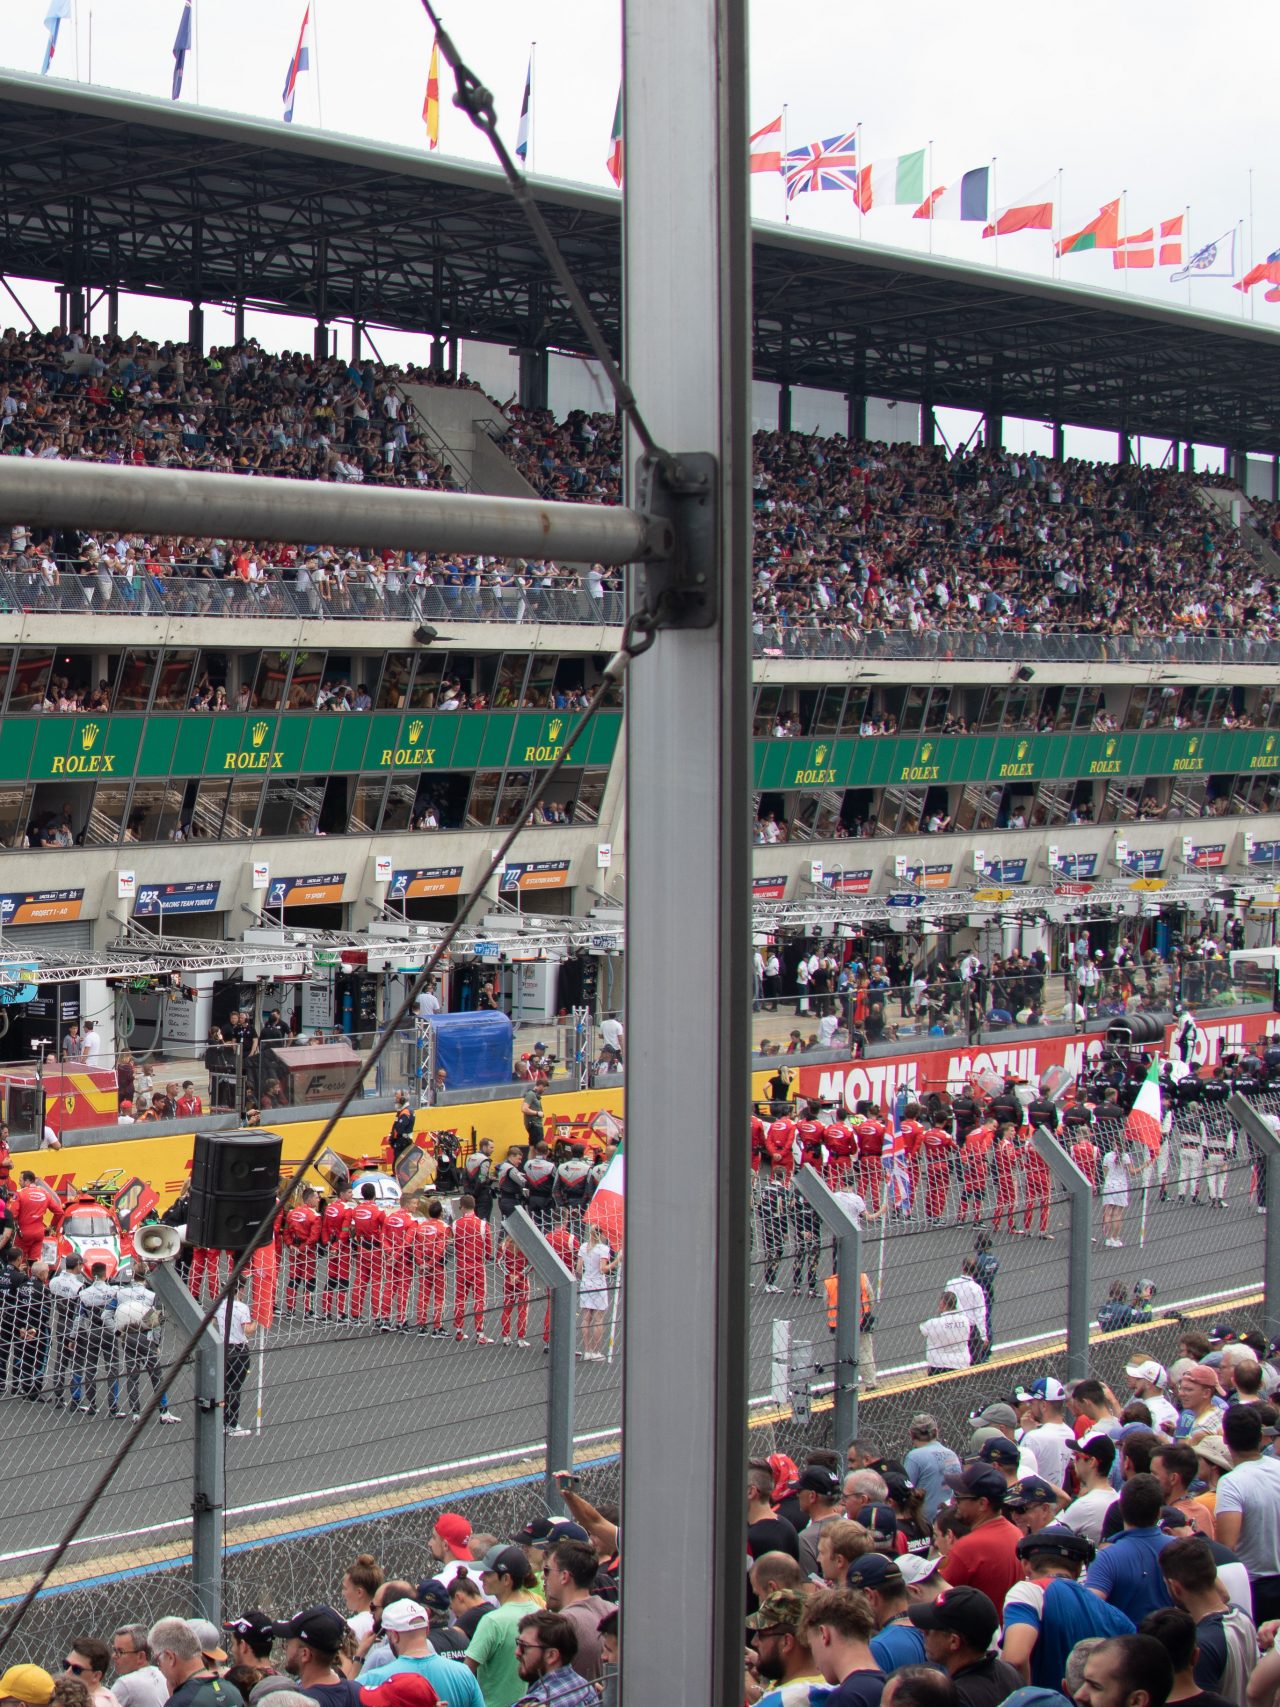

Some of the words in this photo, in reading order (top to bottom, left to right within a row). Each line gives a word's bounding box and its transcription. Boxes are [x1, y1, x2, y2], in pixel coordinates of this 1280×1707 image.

[224, 752, 284, 769] ROLEX
[380, 749, 435, 765] ROLEX
[1250, 756, 1279, 768] ROLEX
[51, 755, 115, 773] ROLEX
[999, 763, 1034, 776] ROLEX
[1089, 760, 1121, 773] ROLEX
[1173, 758, 1204, 770] ROLEX
[794, 769, 837, 784] ROLEX
[901, 766, 939, 780] ROLEX
[506, 869, 522, 881] 777
[396, 876, 408, 887] 25
[998, 891, 1003, 899] 3
[1060, 884, 1072, 894] 311
[139, 891, 158, 903] 923
[195, 898, 214, 906] TURKEY
[911, 896, 917, 905] 2
[818, 1062, 921, 1115] MOTUL
[441, 1650, 466, 1660] RENAU
